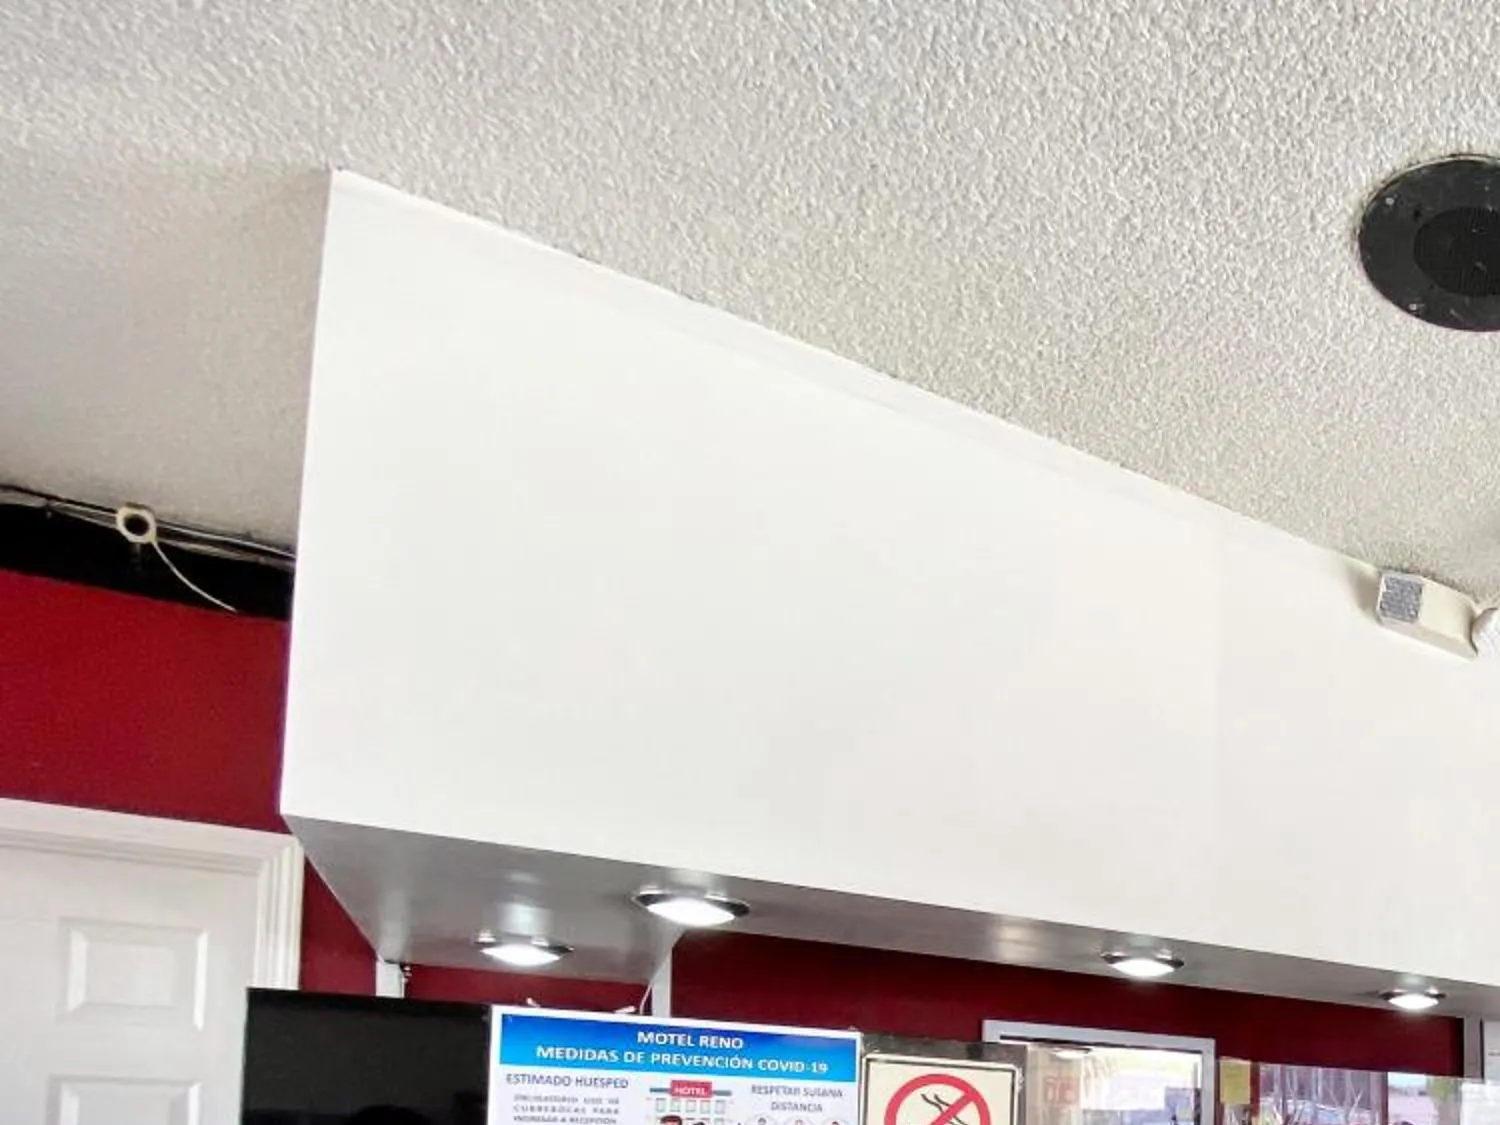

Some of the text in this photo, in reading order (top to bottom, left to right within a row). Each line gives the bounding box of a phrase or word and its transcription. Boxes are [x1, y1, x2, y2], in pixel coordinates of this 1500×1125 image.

[637, 1031, 744, 1049] MOTEL RENO
[536, 1045, 619, 1062] MEDIDAS
[623, 1051, 645, 1064] DE
[651, 1052, 753, 1069] PREVENCIÓN
[506, 1074, 571, 1086] ESTIMADO
[771, 1101, 823, 1112] DISTANCIA
